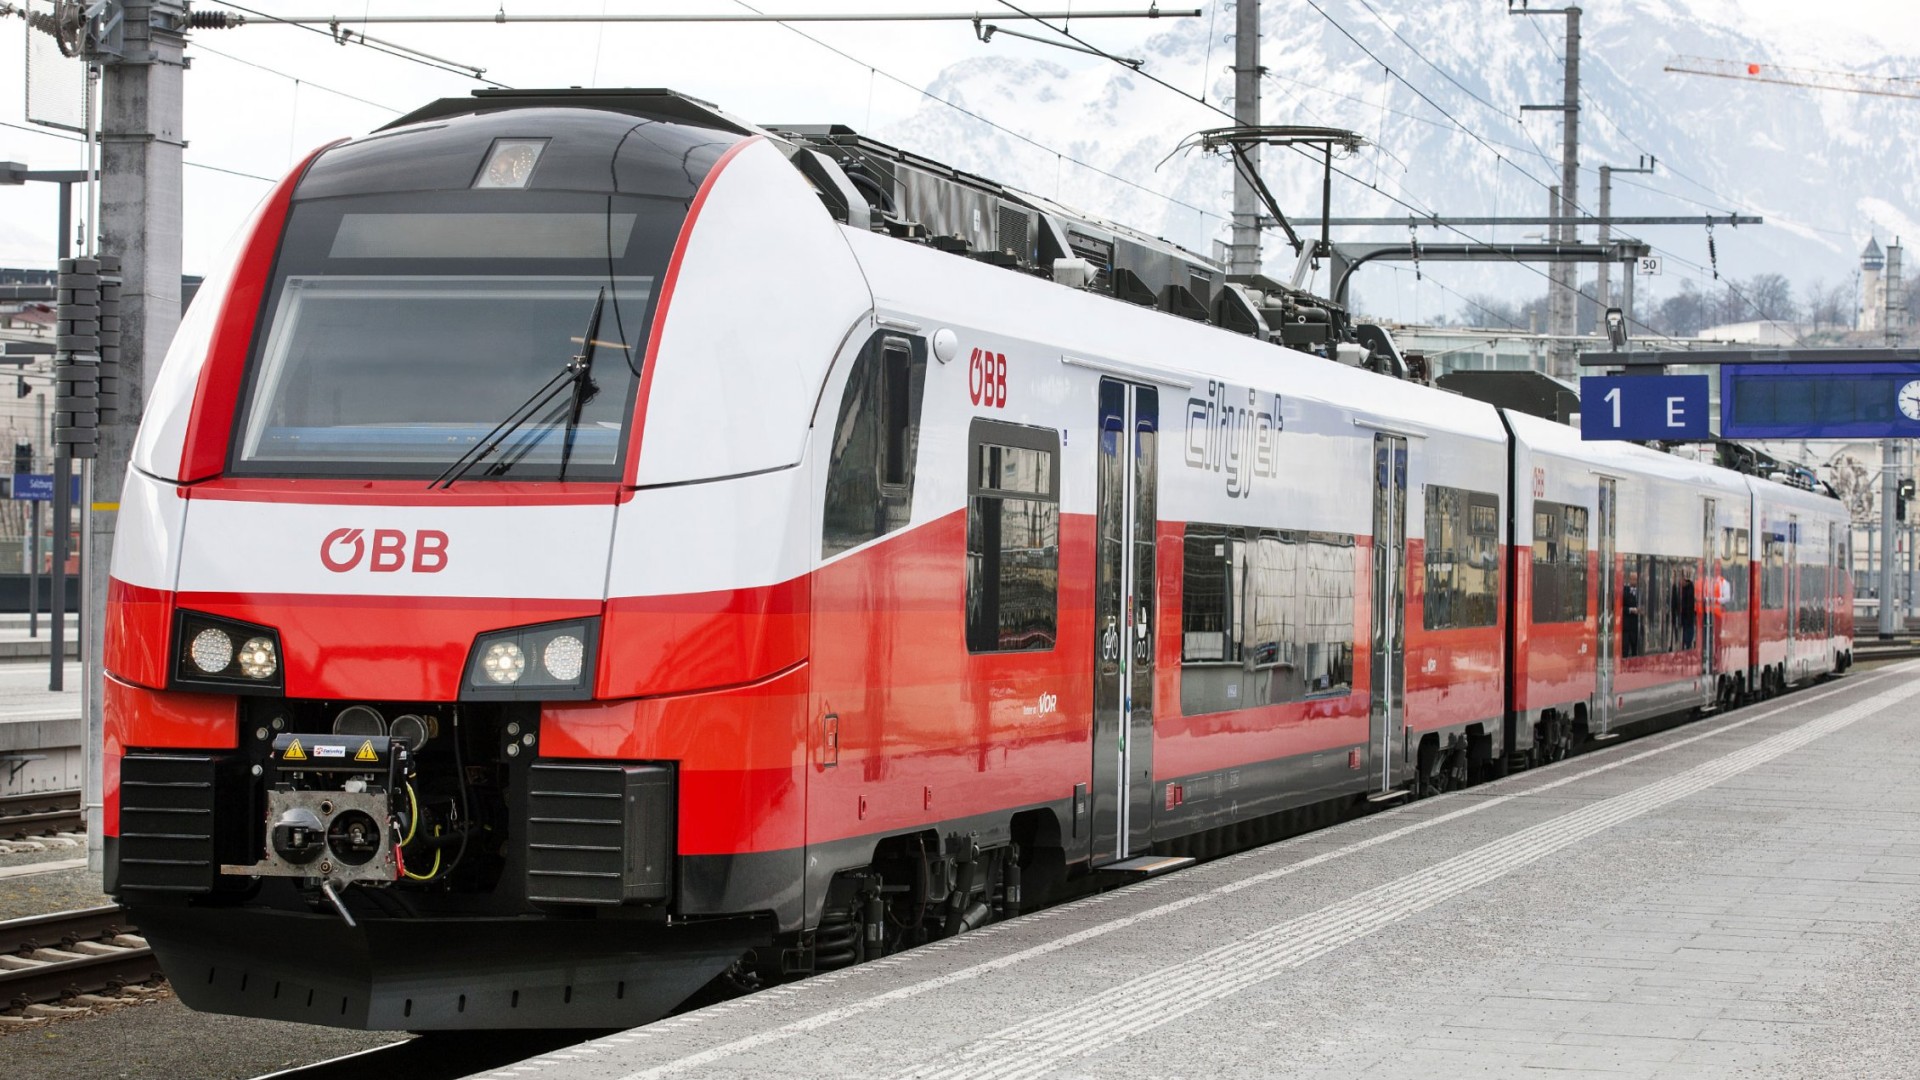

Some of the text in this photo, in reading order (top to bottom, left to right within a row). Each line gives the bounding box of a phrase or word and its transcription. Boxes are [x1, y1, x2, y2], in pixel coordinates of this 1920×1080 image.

[1642, 259, 1656, 270] 50
[969, 347, 1007, 408] ÖBB
[1603, 387, 1686, 428] 1 E
[1185, 379, 1284, 499] cityjet
[320, 527, 450, 573] ÖBB
[1038, 691, 1057, 718] VOR
